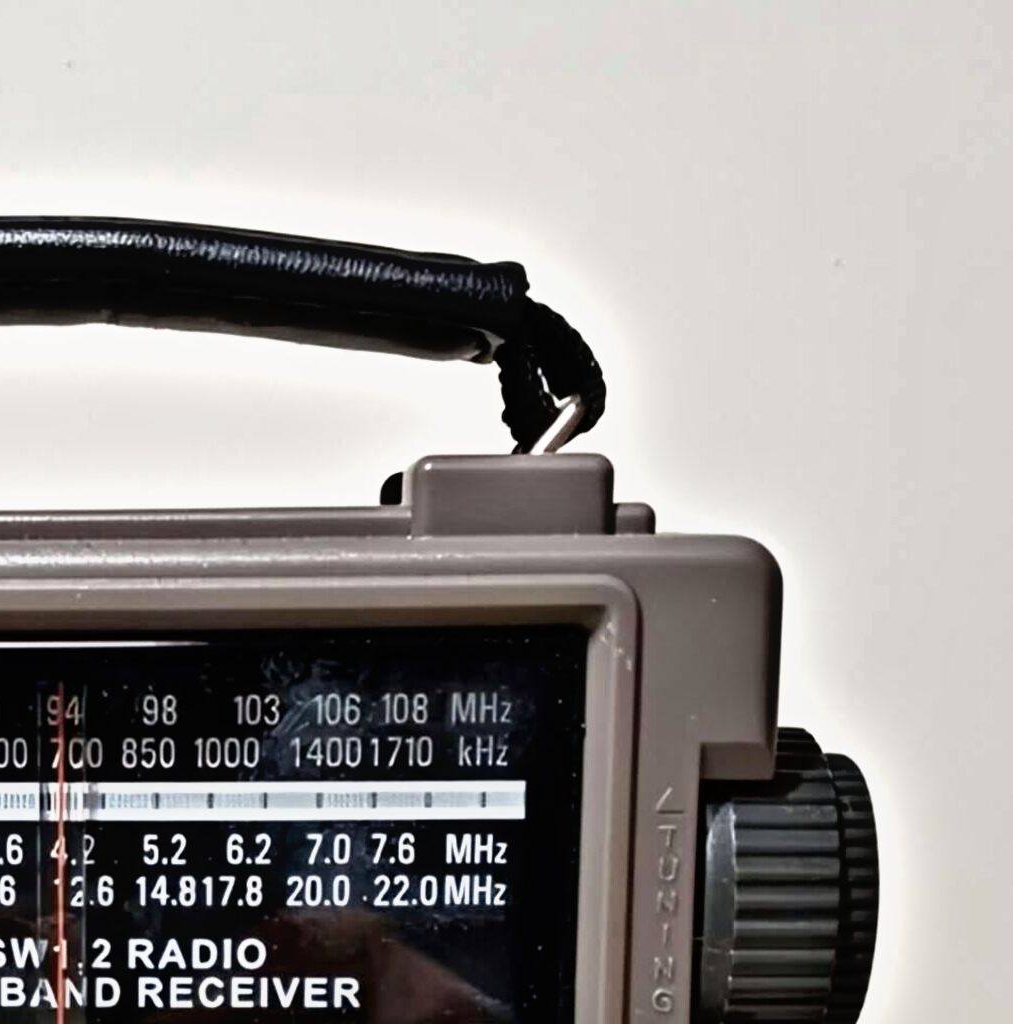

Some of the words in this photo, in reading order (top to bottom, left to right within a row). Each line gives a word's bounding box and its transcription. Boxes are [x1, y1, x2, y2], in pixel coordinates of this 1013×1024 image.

[46, 694, 83, 727] 94
[142, 694, 178, 726] 98
[234, 693, 281, 726] 103
[315, 693, 362, 725] 106
[382, 693, 428, 725] 108
[450, 692, 512, 725] MHz
[50, 737, 103, 770] 700
[122, 737, 176, 769] 850
[194, 737, 260, 769] 1000
[292, 736, 362, 768] 1400
[371, 736, 433, 768] 1710
[458, 735, 509, 767] kHz
[50, 833, 96, 866] 4.2
[142, 833, 187, 866] 5.2
[225, 833, 272, 866] 6.2
[306, 833, 351, 865] 7.0
[371, 832, 416, 865] 7.6
[445, 833, 507, 865] MHz
[53, 874, 115, 907] 2.6
[135, 875, 196, 907] 14.8
[202, 875, 263, 907] 17.8
[286, 875, 351, 907] 20.0
[373, 875, 438, 906] 22.0
[444, 875, 507, 906] MHz
[651, 825, 679, 1013] TUNING
[128, 937, 267, 970] RADIO
[0, 976, 122, 1008] BAND
[137, 976, 362, 1009] RECEIVER
